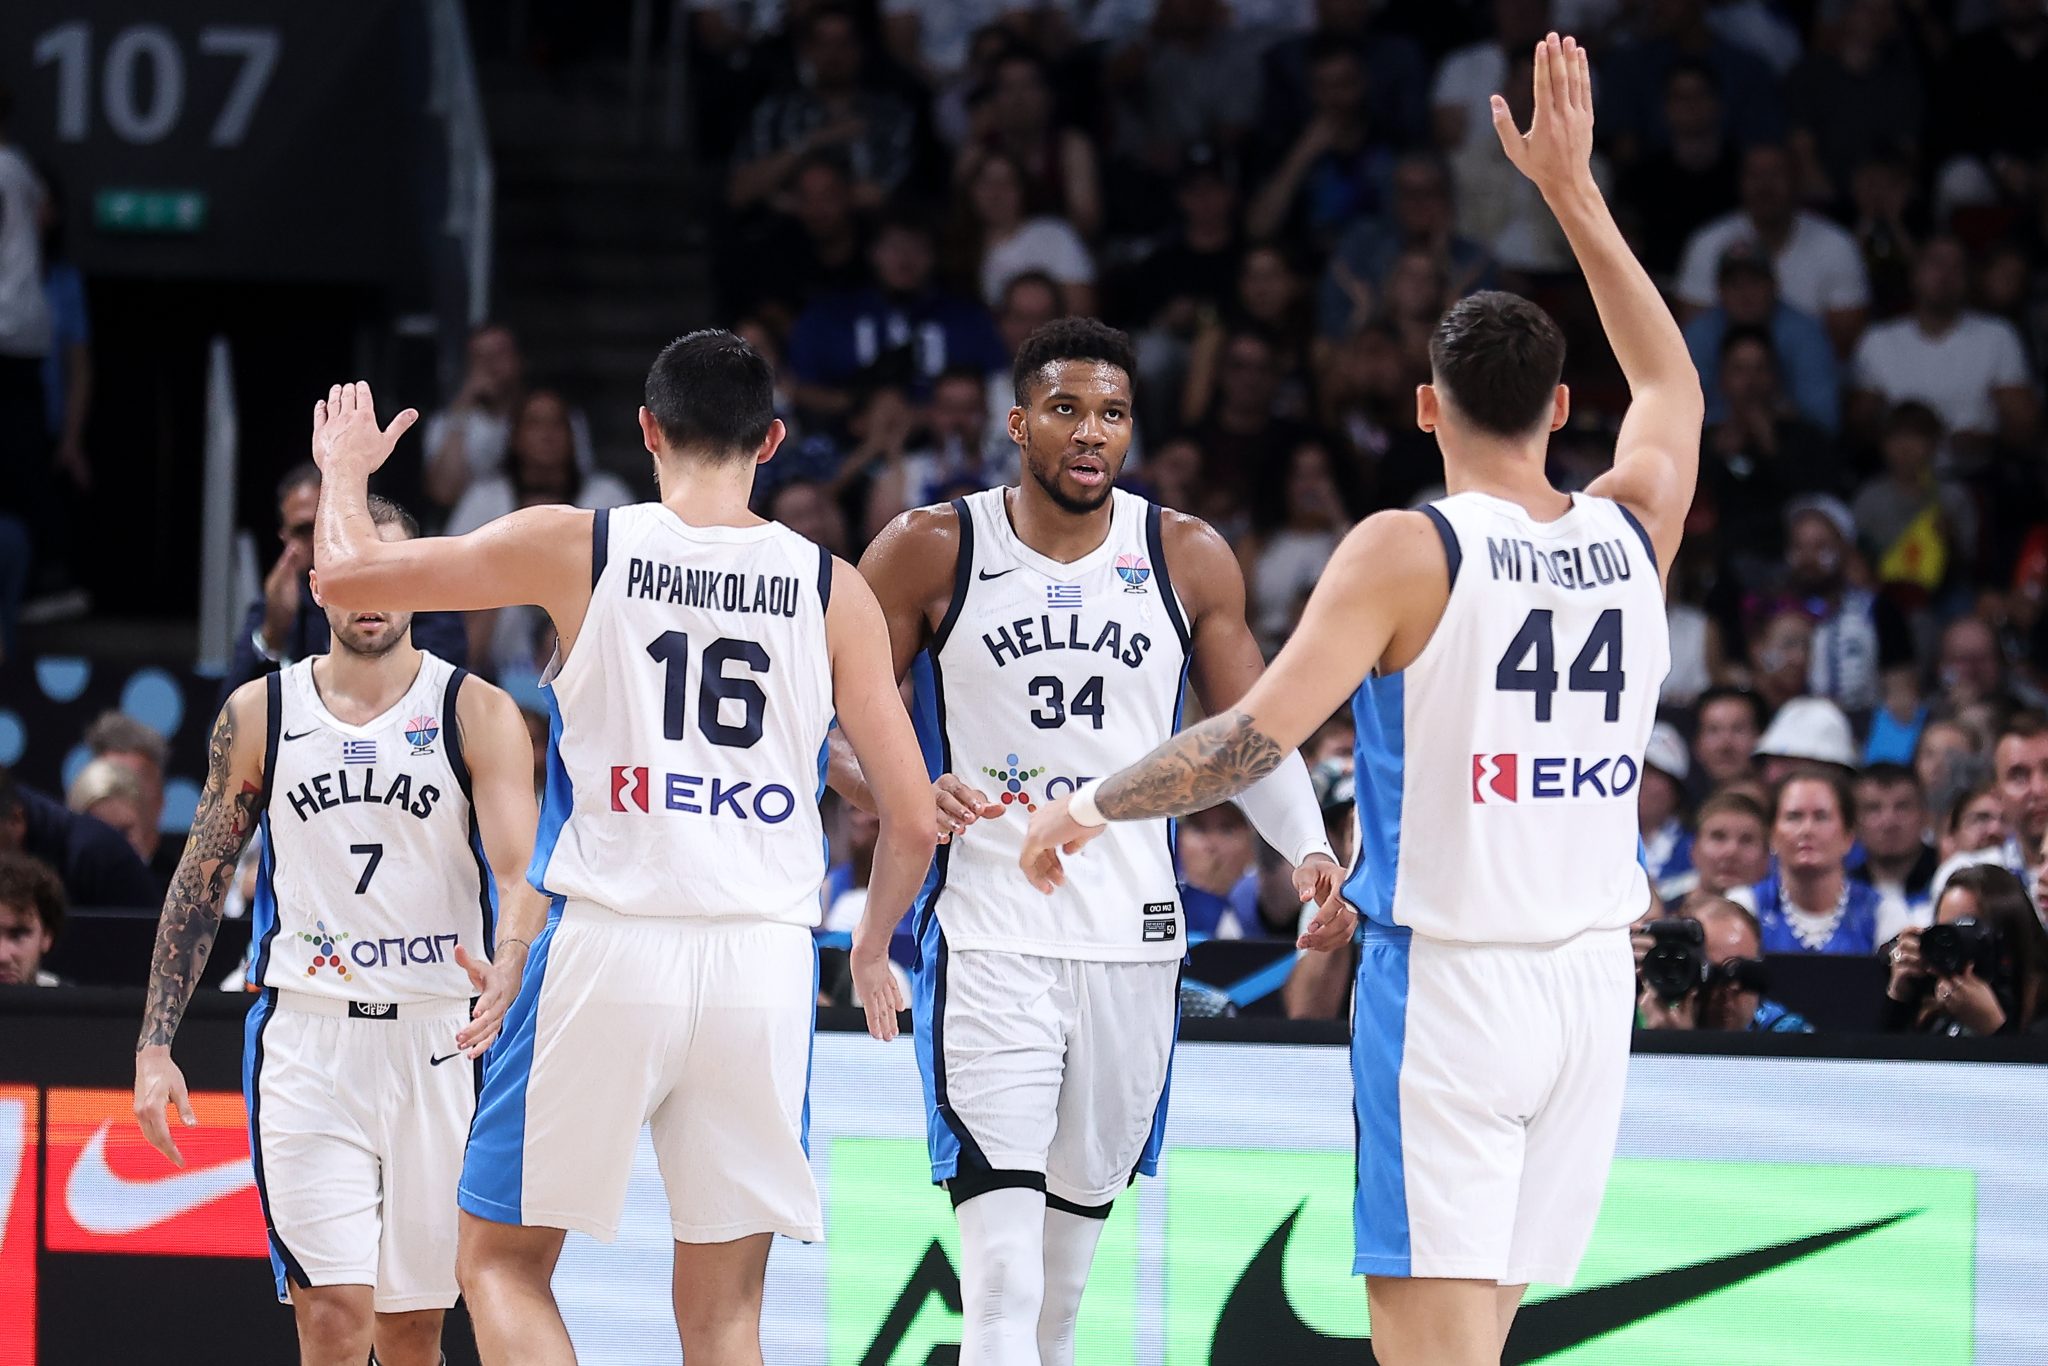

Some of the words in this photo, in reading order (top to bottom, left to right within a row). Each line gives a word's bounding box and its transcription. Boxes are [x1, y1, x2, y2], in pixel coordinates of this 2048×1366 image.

[33, 21, 280, 147] 107
[627, 557, 799, 618] PAPANIKOLAOU
[982, 614, 1151, 668] HELLAS
[1496, 608, 1625, 723] 44
[646, 630, 771, 749] 16
[1028, 675, 1104, 730] 34
[286, 768, 441, 823] HELLAS
[666, 772, 795, 824] EKO
[1532, 754, 1638, 799] EKO
[349, 843, 383, 895] 7
